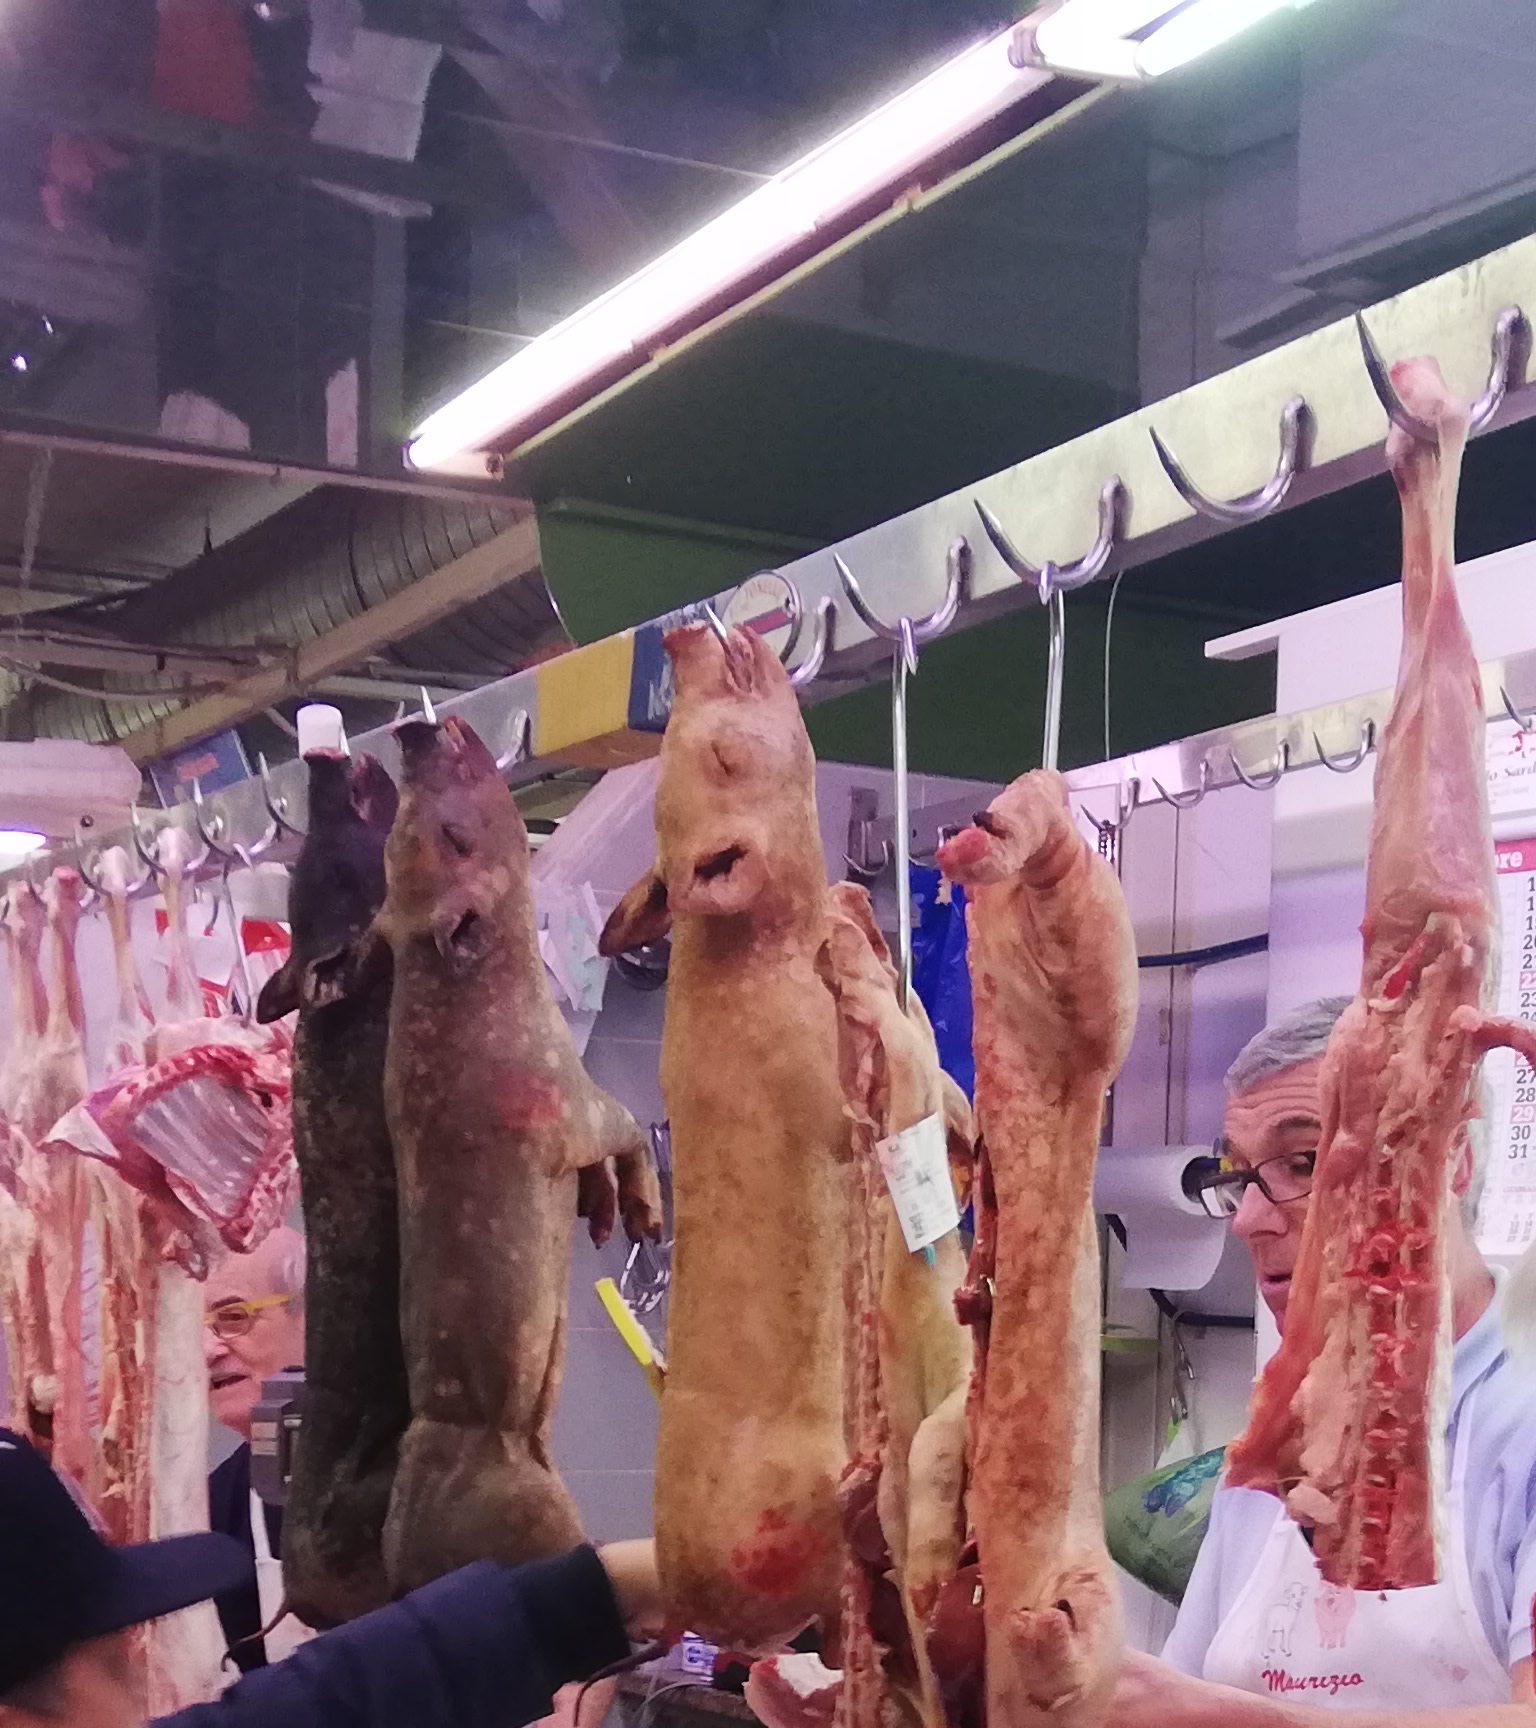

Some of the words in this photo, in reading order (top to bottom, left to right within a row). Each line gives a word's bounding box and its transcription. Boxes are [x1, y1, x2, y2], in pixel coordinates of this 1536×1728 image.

[1516, 1068, 1536, 1084] 27
[1515, 1087, 1536, 1103] 28
[1513, 1105, 1535, 1122] 29
[1510, 1124, 1531, 1141] 30
[1507, 1144, 1528, 1160] 31
